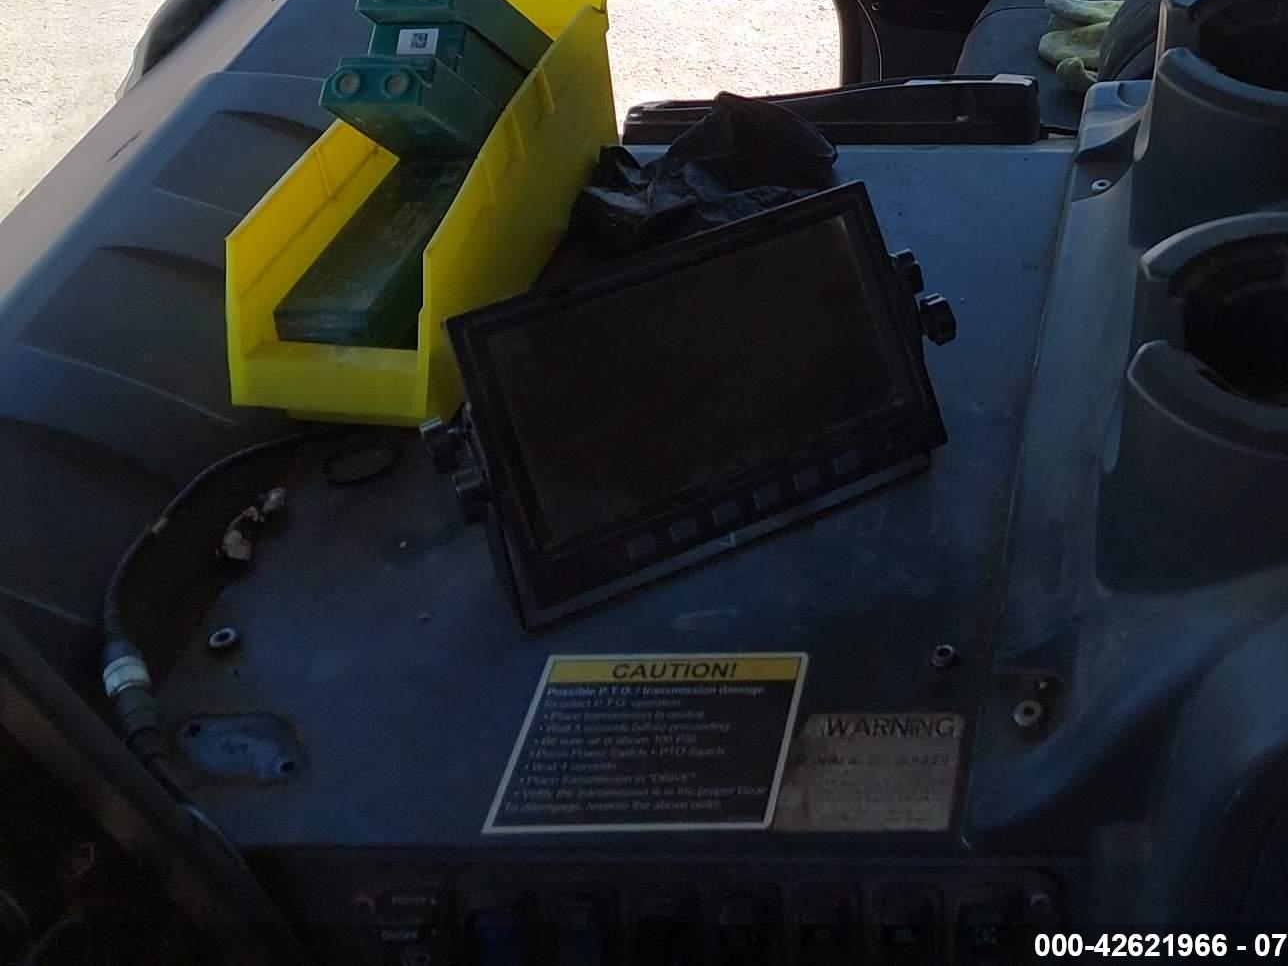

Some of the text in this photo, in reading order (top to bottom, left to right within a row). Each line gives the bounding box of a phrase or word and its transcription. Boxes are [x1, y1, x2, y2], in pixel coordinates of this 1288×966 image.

[611, 662, 737, 679] CAUTION!
[548, 686, 597, 696] Possible
[642, 685, 716, 696] transmission
[826, 716, 955, 736] WARNING
